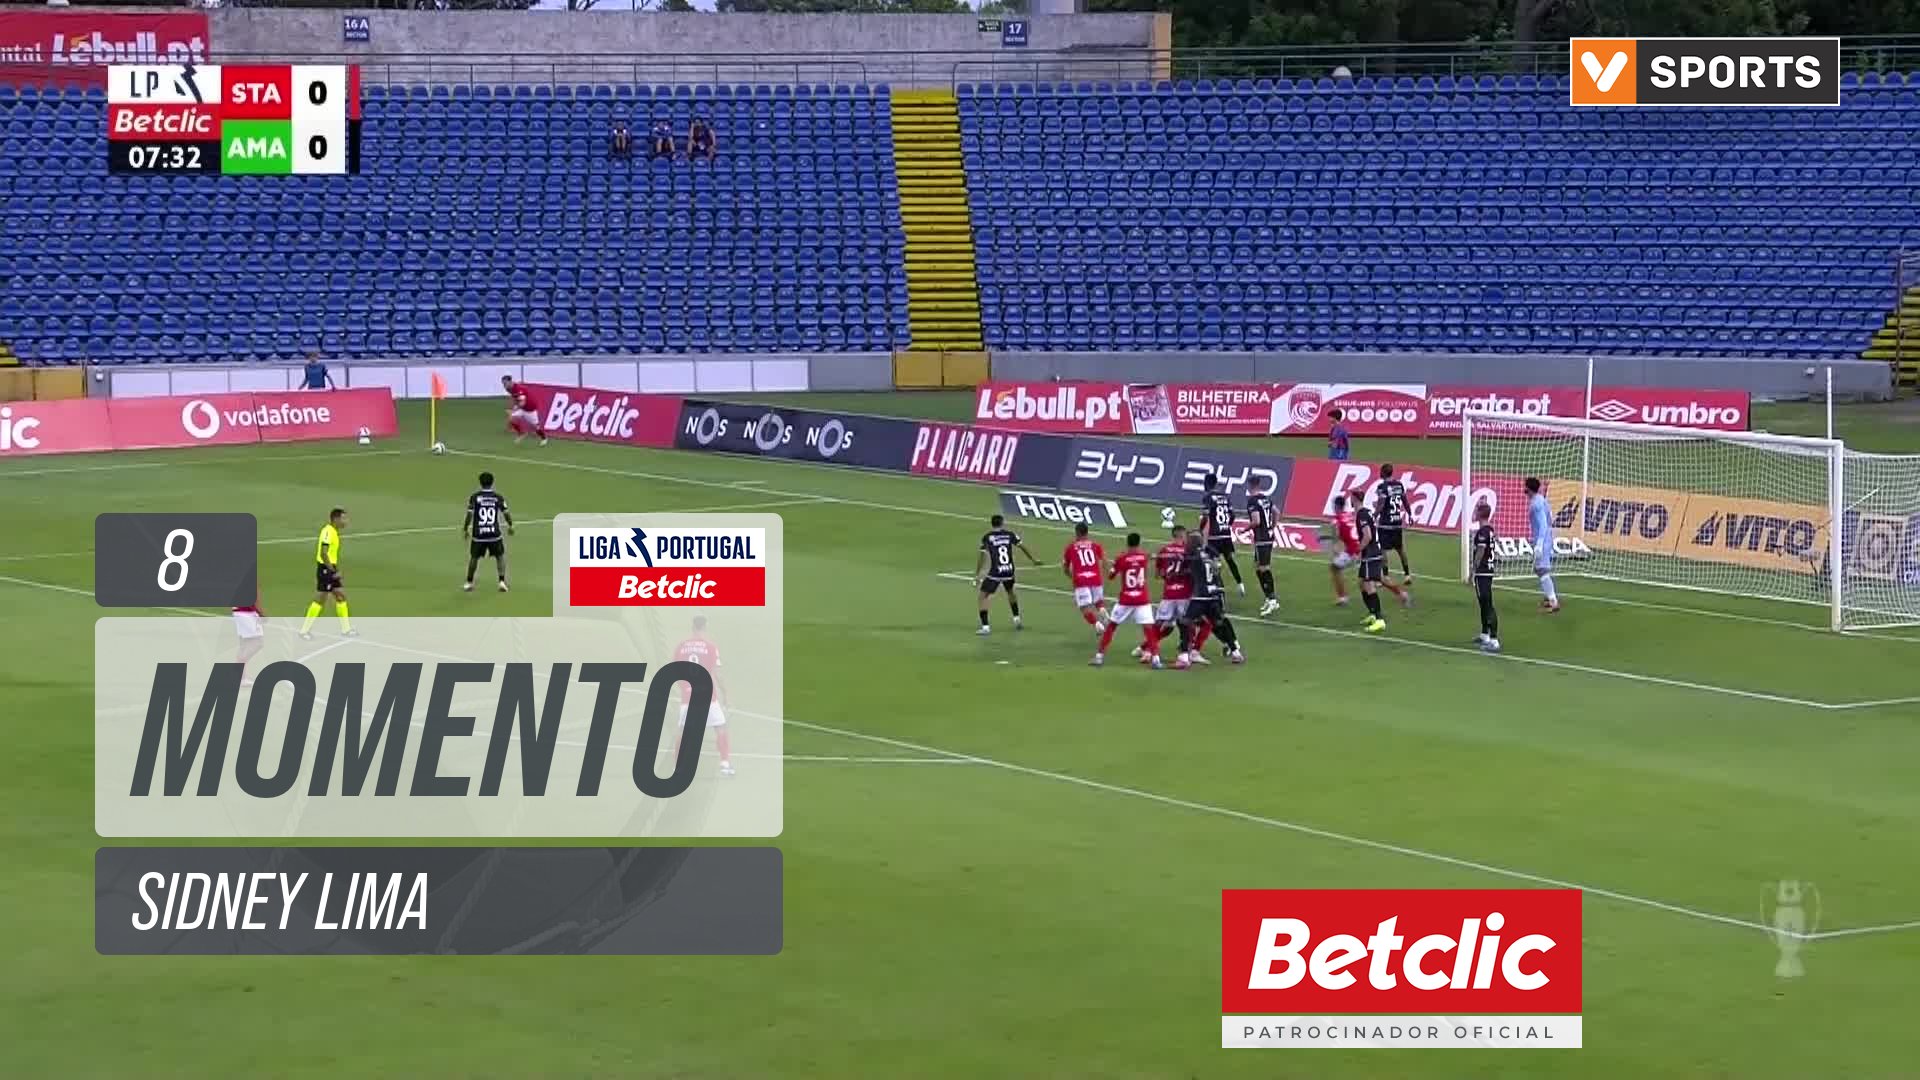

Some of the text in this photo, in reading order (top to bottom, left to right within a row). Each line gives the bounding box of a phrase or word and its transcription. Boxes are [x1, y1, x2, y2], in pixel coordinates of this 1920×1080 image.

[359, 18, 369, 30] A
[1008, 23, 1022, 34] 17
[52, 32, 204, 66] Lebull.pt
[976, 386, 1122, 428] Lebull.pt
[1177, 389, 1271, 404] BILHETEIRA
[223, 402, 331, 427] vodafone
[544, 392, 640, 438] Betclic
[1176, 404, 1238, 418] ONLINE
[1641, 401, 1740, 425] umbro
[685, 408, 728, 445] NOS
[743, 413, 793, 450] NOS
[805, 418, 854, 457] NOS
[911, 427, 1018, 477] PLACARD
[1075, 450, 1165, 485] BYD
[478, 507, 496, 526] 99
[1015, 495, 1093, 525] Haier
[998, 545, 1009, 565] 8
[1077, 548, 1096, 566] 10
[1493, 536, 1592, 556] ABACA
[1125, 567, 1145, 588] 64
